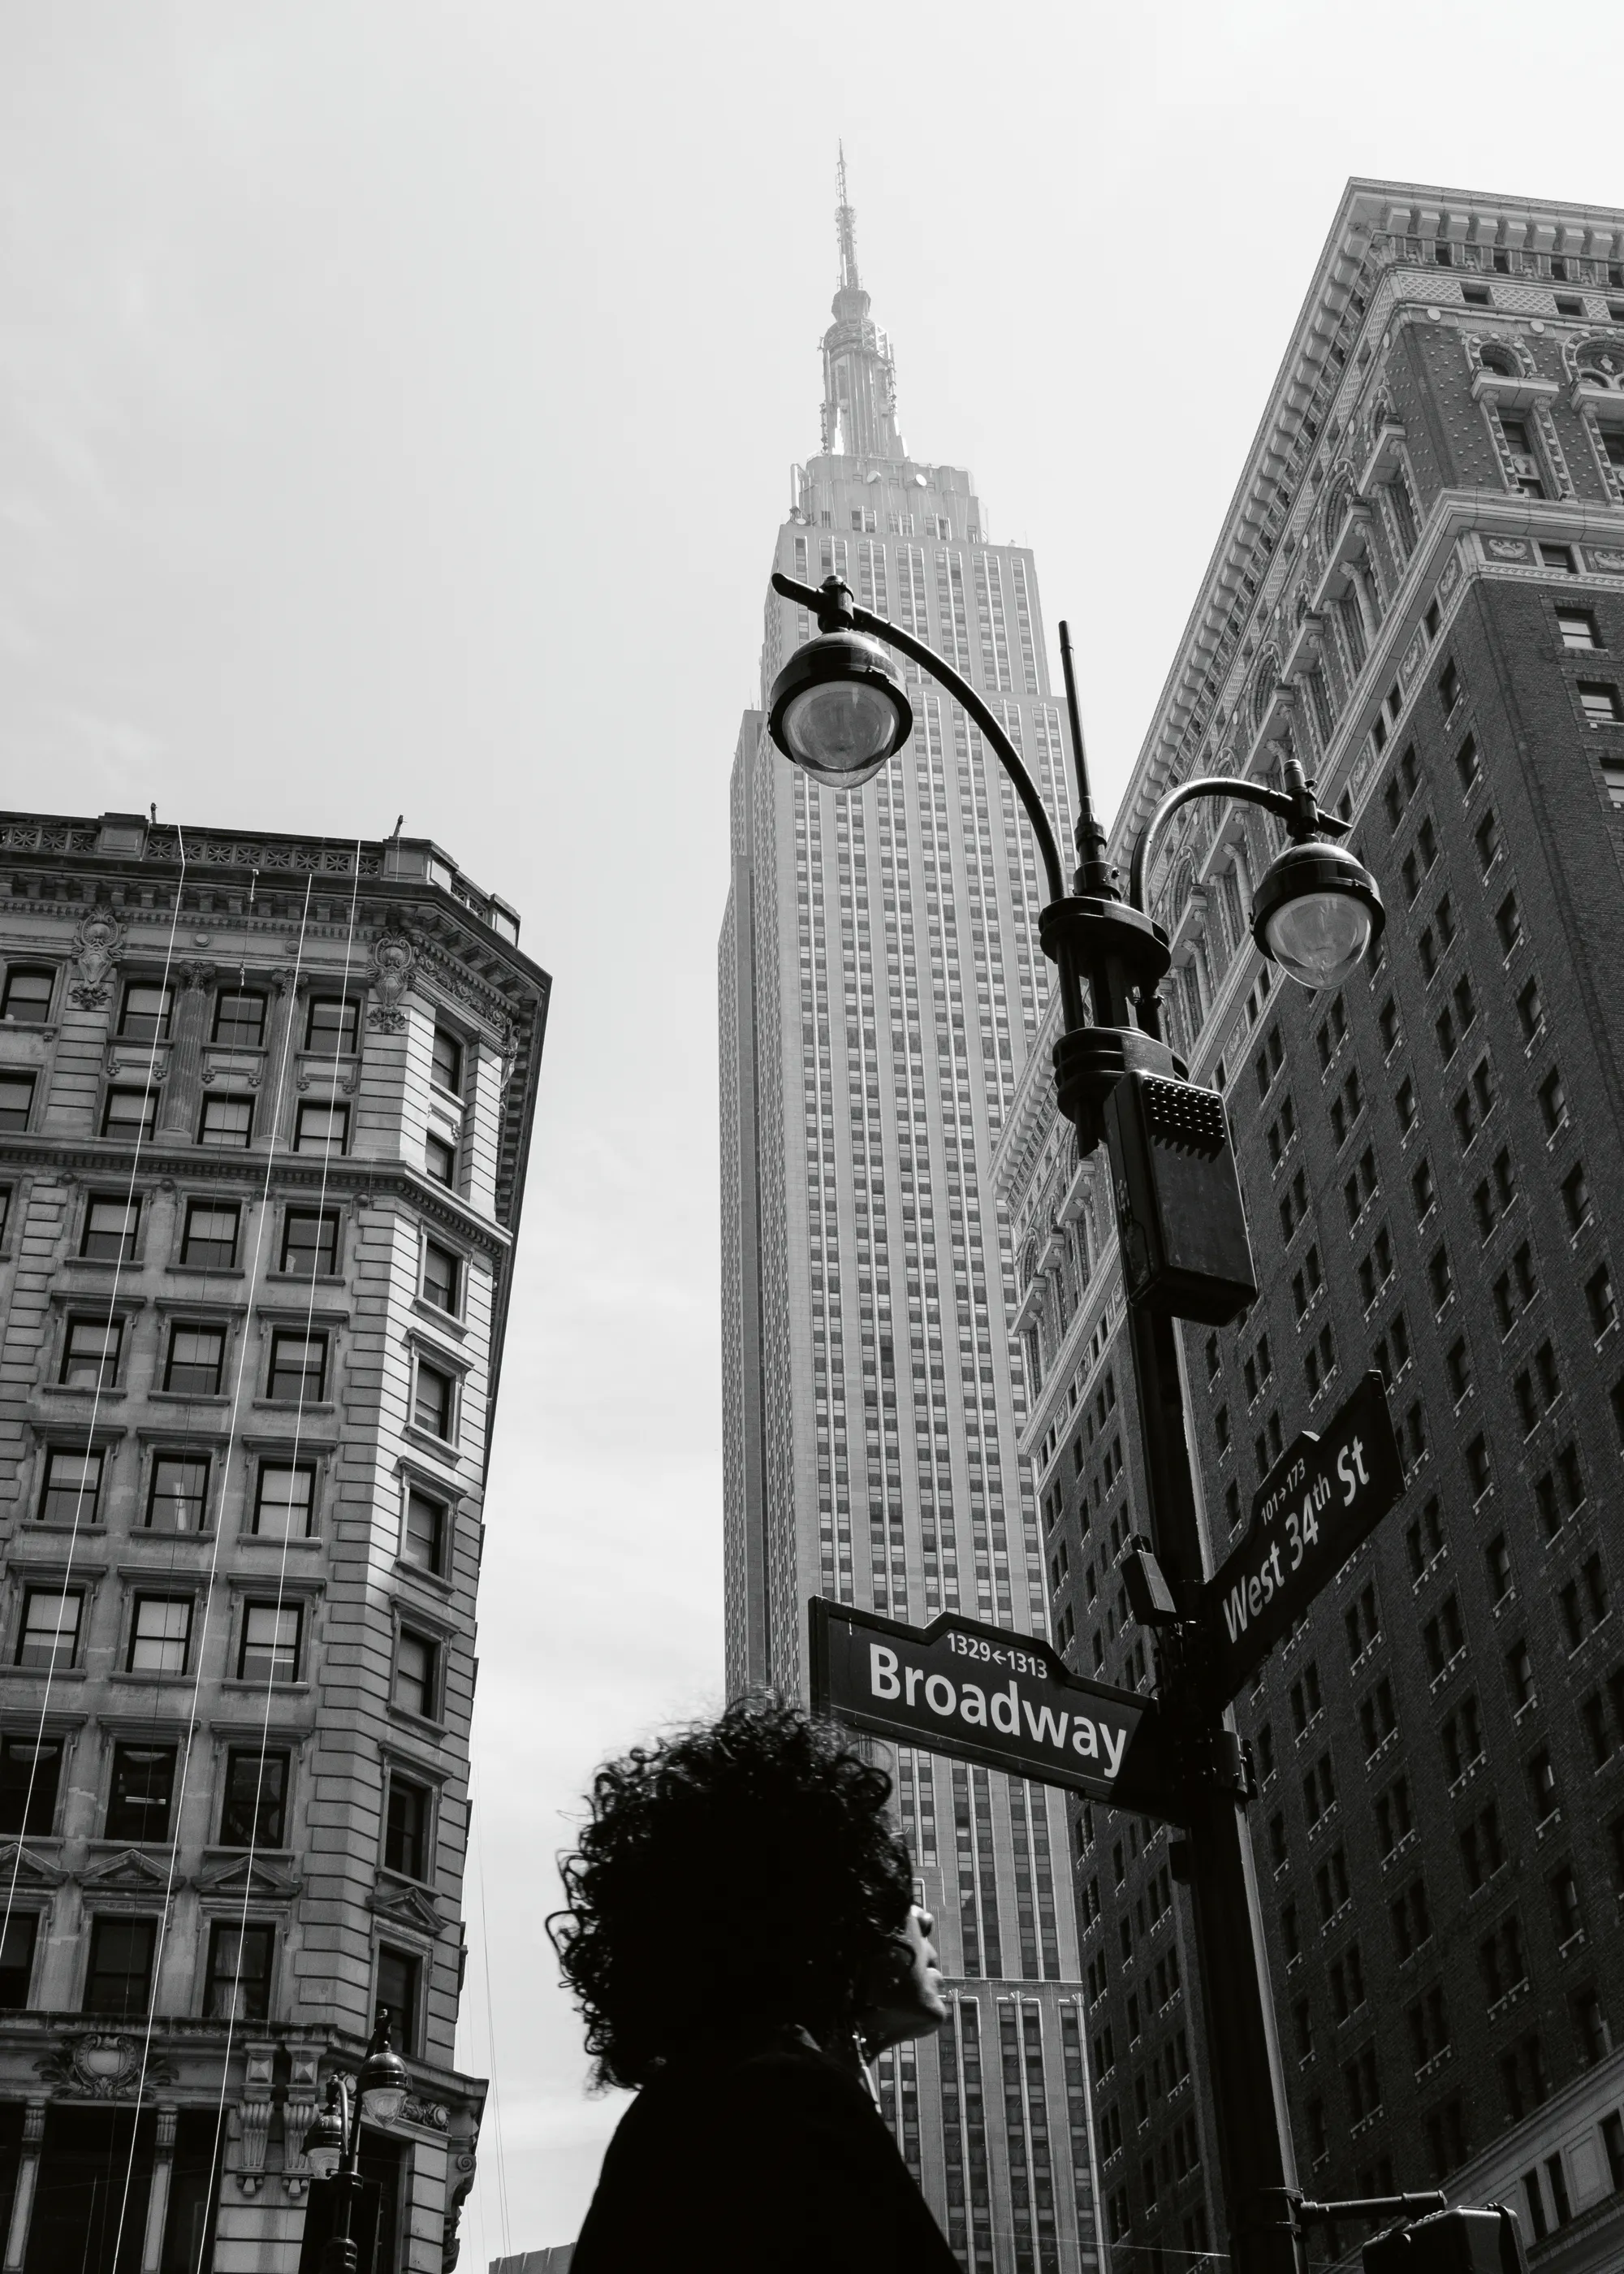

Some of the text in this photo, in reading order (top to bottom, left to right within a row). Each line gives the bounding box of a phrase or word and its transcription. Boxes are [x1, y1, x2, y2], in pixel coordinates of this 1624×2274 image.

[1222, 1435, 1370, 1644] West 34th St
[870, 1642, 1127, 1779] Broadway
